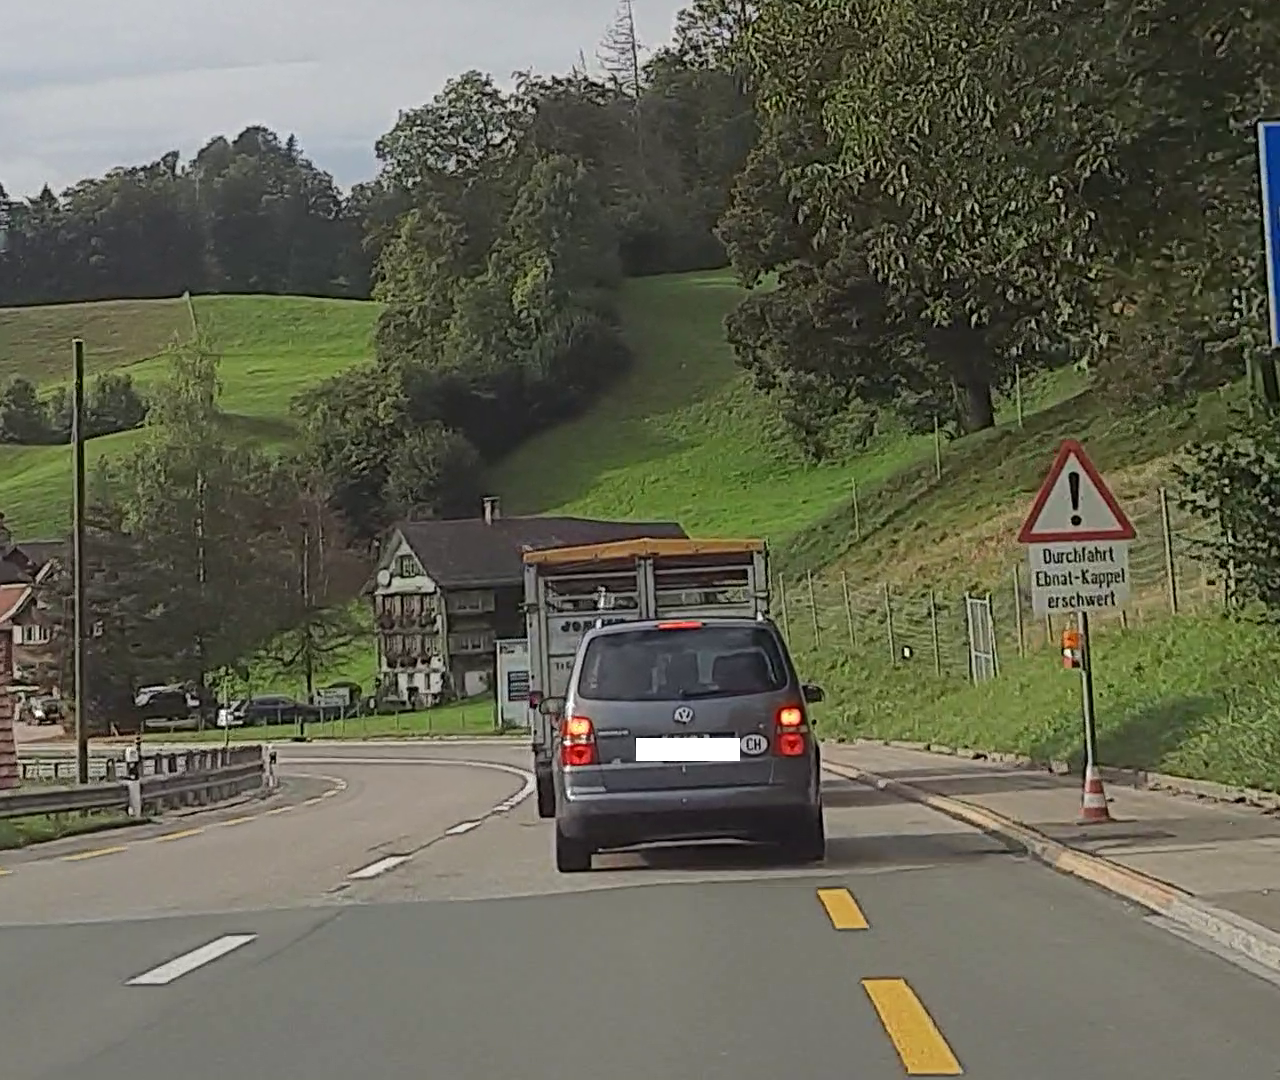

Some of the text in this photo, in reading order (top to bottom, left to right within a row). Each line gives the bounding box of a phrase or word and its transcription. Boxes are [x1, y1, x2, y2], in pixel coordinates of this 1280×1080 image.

[1043, 546, 1115, 565] Durchfahrt
[1035, 568, 1125, 588] Ebnat-Kappel
[1048, 592, 1116, 609] erschwert
[745, 737, 763, 752] CH
